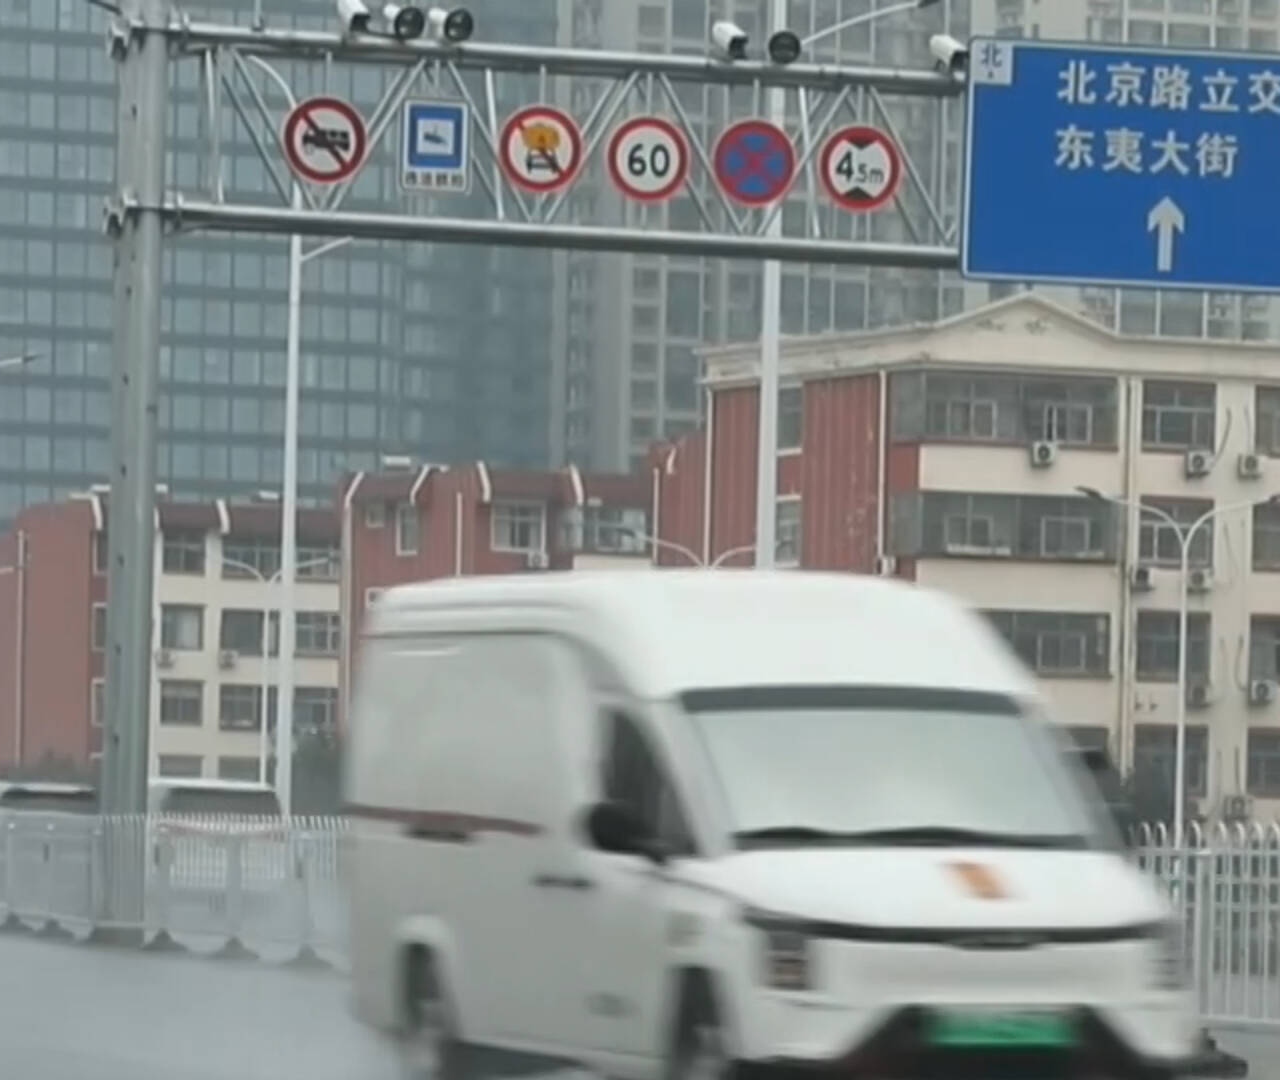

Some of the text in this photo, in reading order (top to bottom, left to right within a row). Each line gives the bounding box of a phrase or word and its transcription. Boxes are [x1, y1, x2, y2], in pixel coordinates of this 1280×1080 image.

[980, 42, 1003, 68] 北
[627, 143, 670, 177] 60
[1054, 123, 1239, 179] 东夷大街
